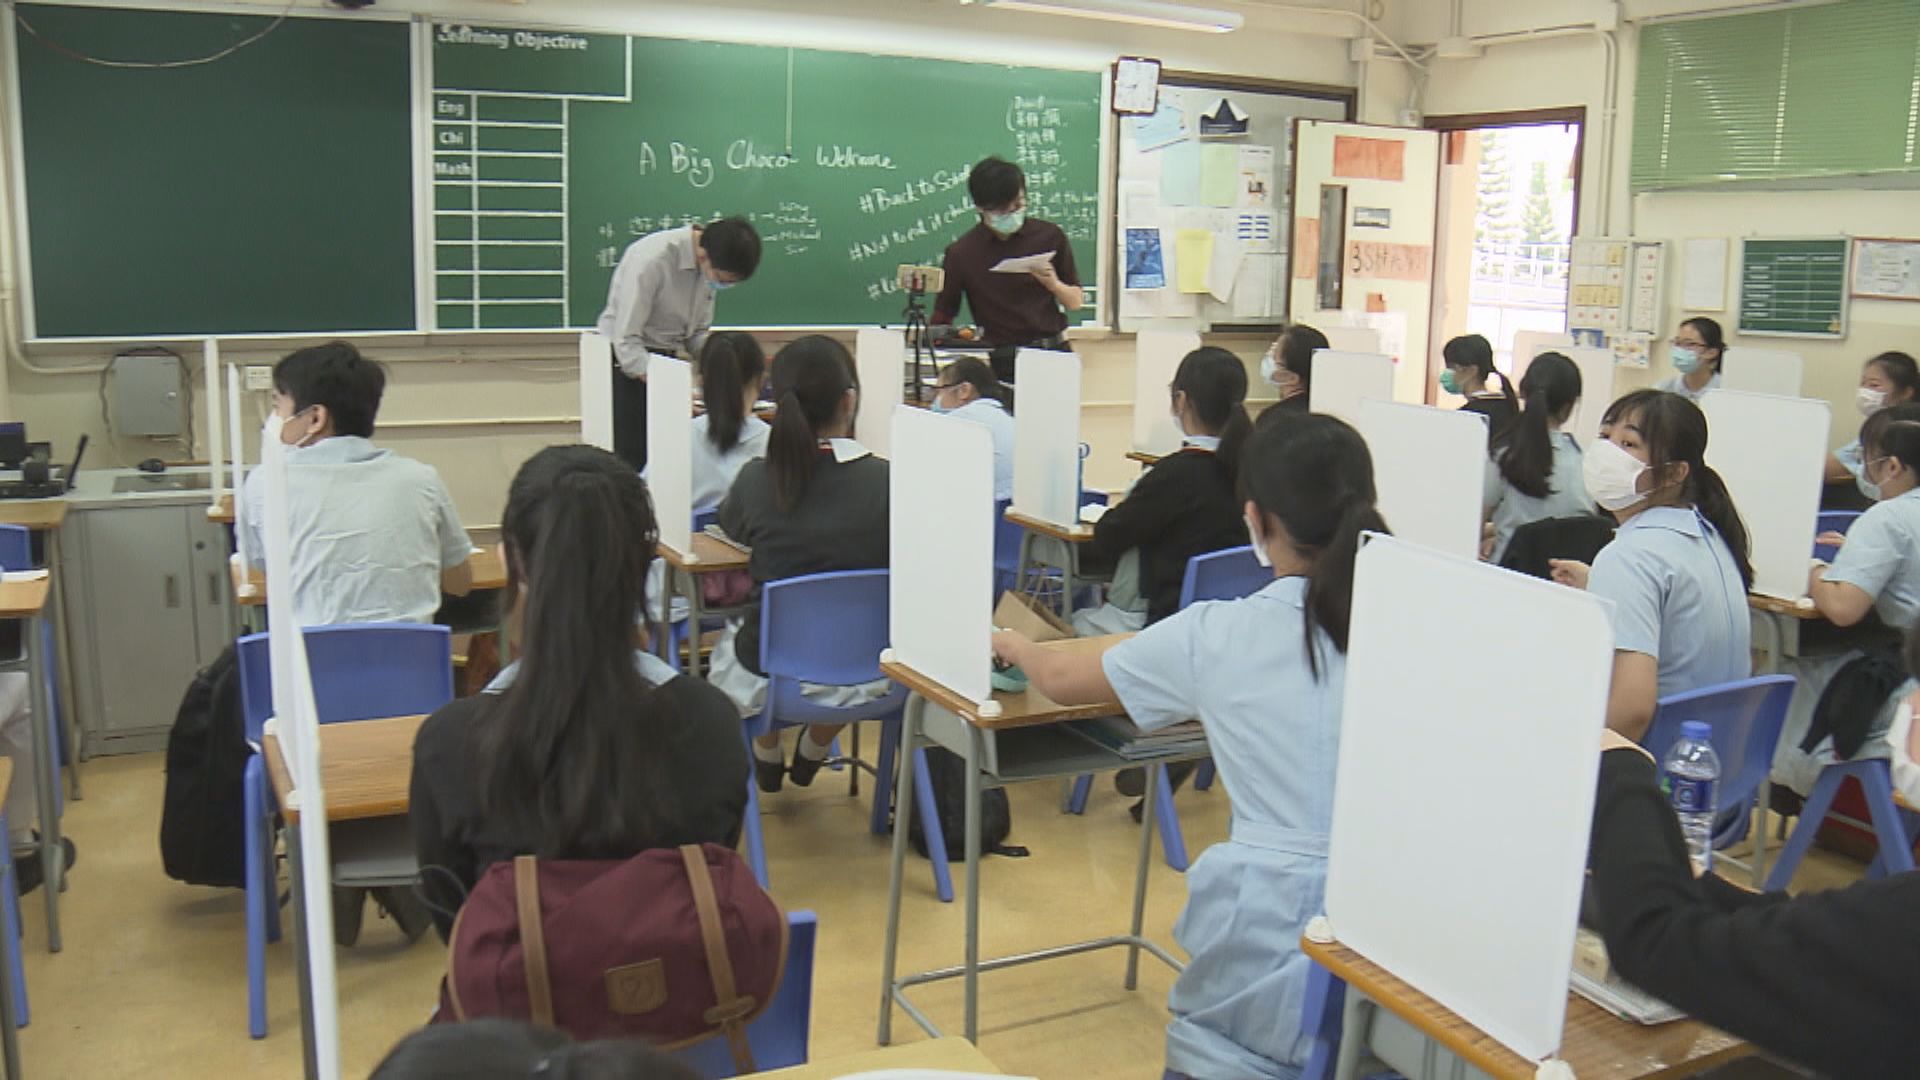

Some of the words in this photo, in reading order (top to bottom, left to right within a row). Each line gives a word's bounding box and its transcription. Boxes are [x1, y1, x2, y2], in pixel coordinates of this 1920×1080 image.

[513, 31, 588, 51] Objective
[438, 99, 465, 118] Eng
[438, 130, 464, 146] Chi
[435, 162, 470, 176] Math
[640, 142, 657, 176] A
[669, 141, 715, 188] Big
[816, 144, 897, 170] Welcome
